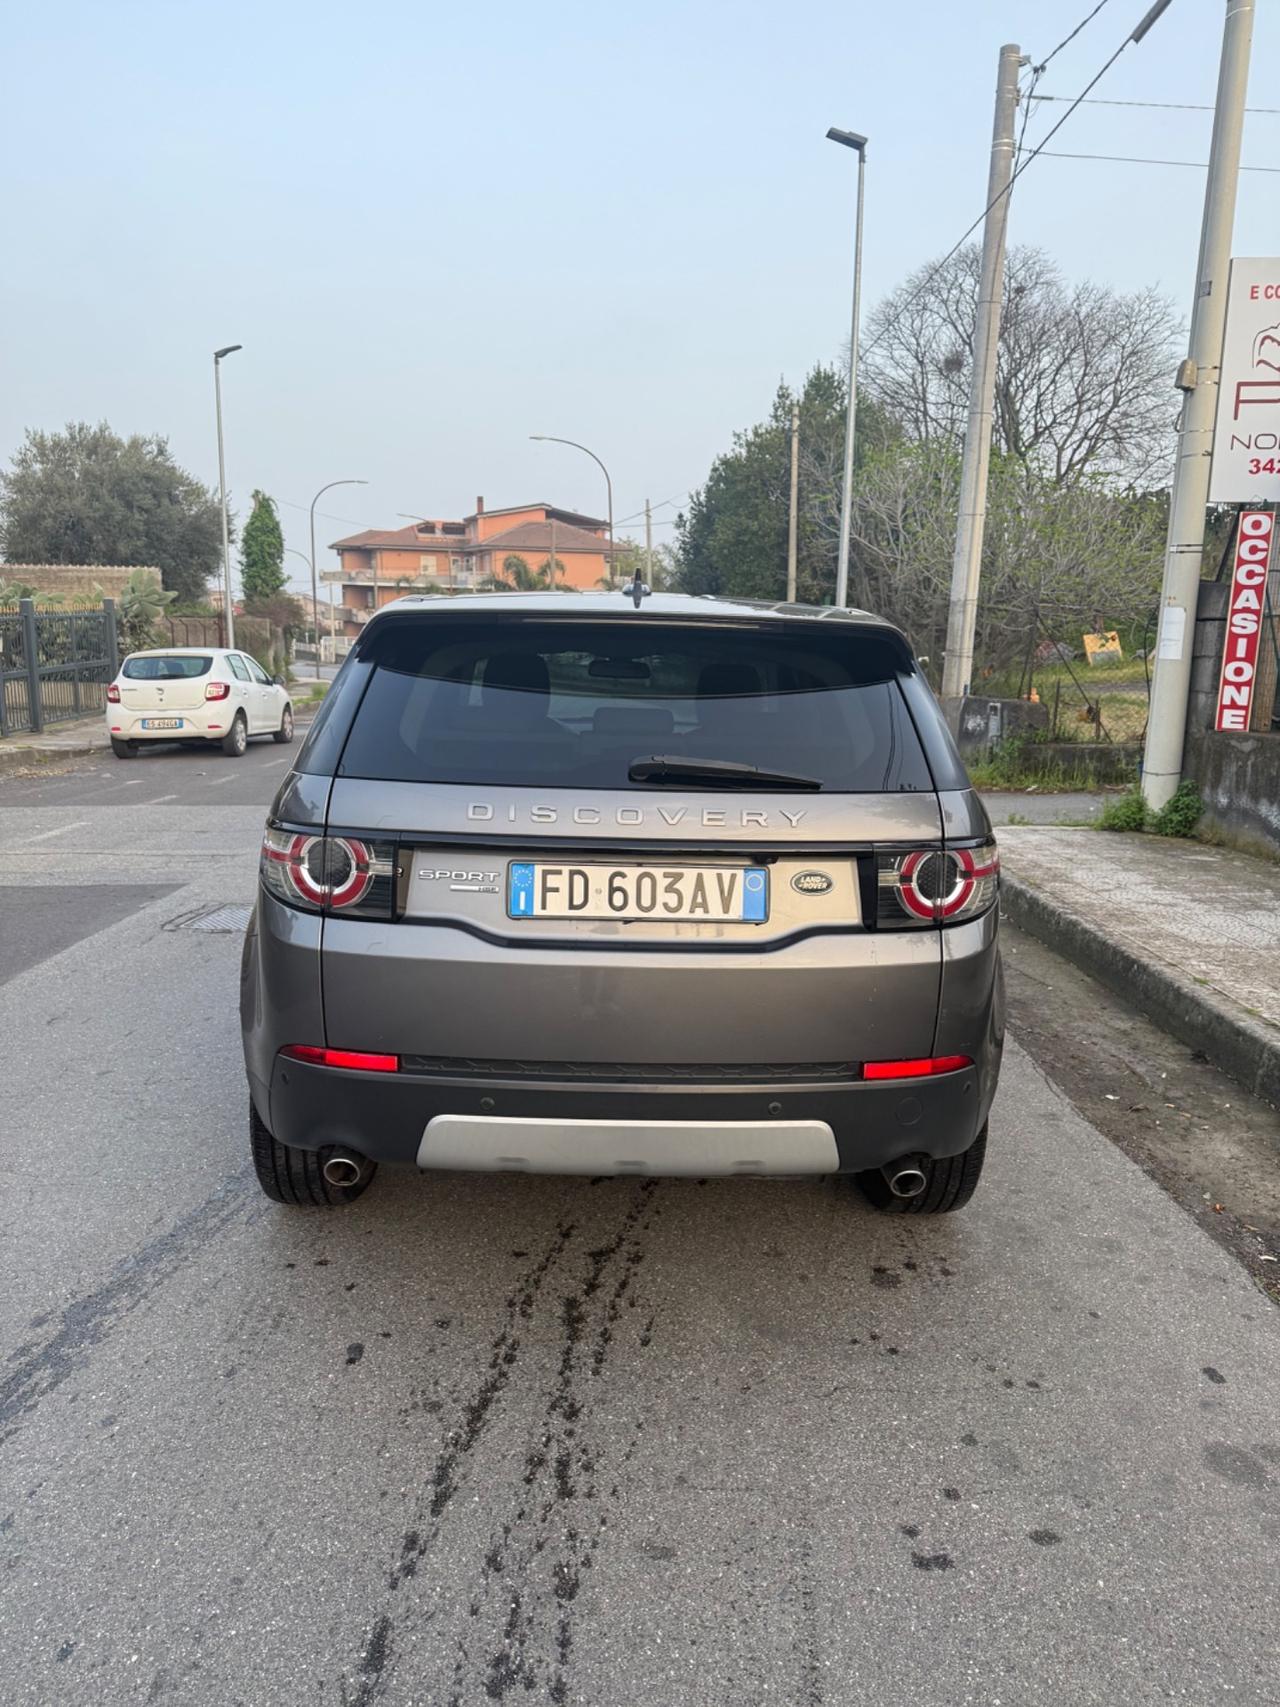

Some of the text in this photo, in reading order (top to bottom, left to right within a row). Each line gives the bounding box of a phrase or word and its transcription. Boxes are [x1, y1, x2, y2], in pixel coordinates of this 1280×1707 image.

[1250, 285, 1260, 300] E
[1230, 433, 1280, 451] NO
[1220, 514, 1272, 729] OCCASIONE
[467, 802, 807, 828] DISCOVERY
[419, 869, 499, 882] SPORT
[540, 868, 589, 911] FD
[607, 870, 738, 915] 603AV
